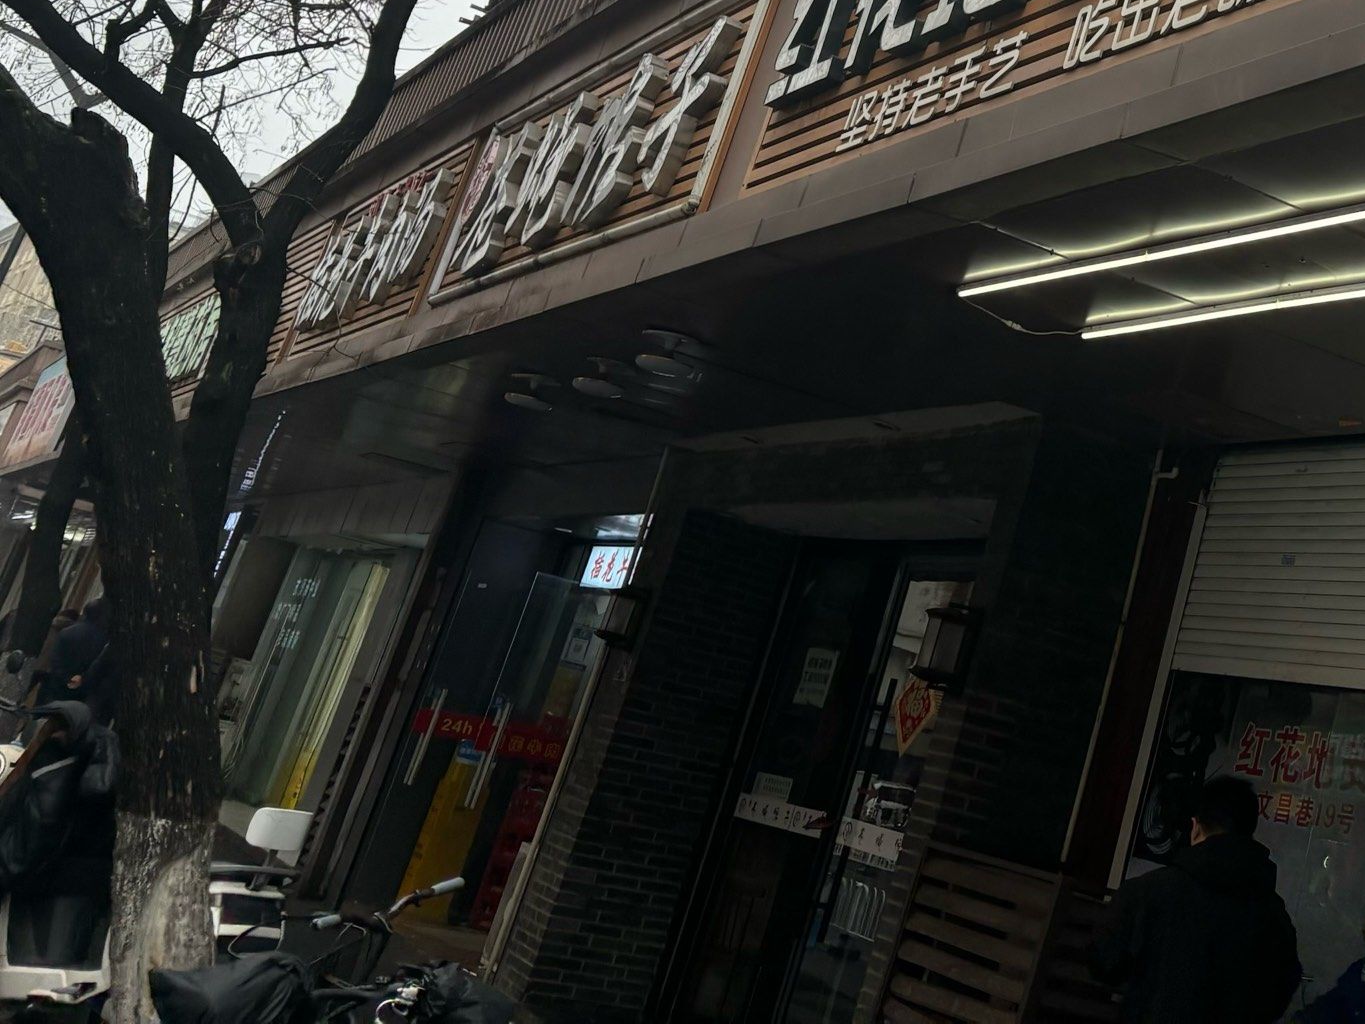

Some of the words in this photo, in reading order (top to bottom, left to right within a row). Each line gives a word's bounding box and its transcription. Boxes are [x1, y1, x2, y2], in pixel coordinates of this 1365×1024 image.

[836, 31, 1030, 153] 坚持老手艺
[440, 718, 474, 736] 24h
